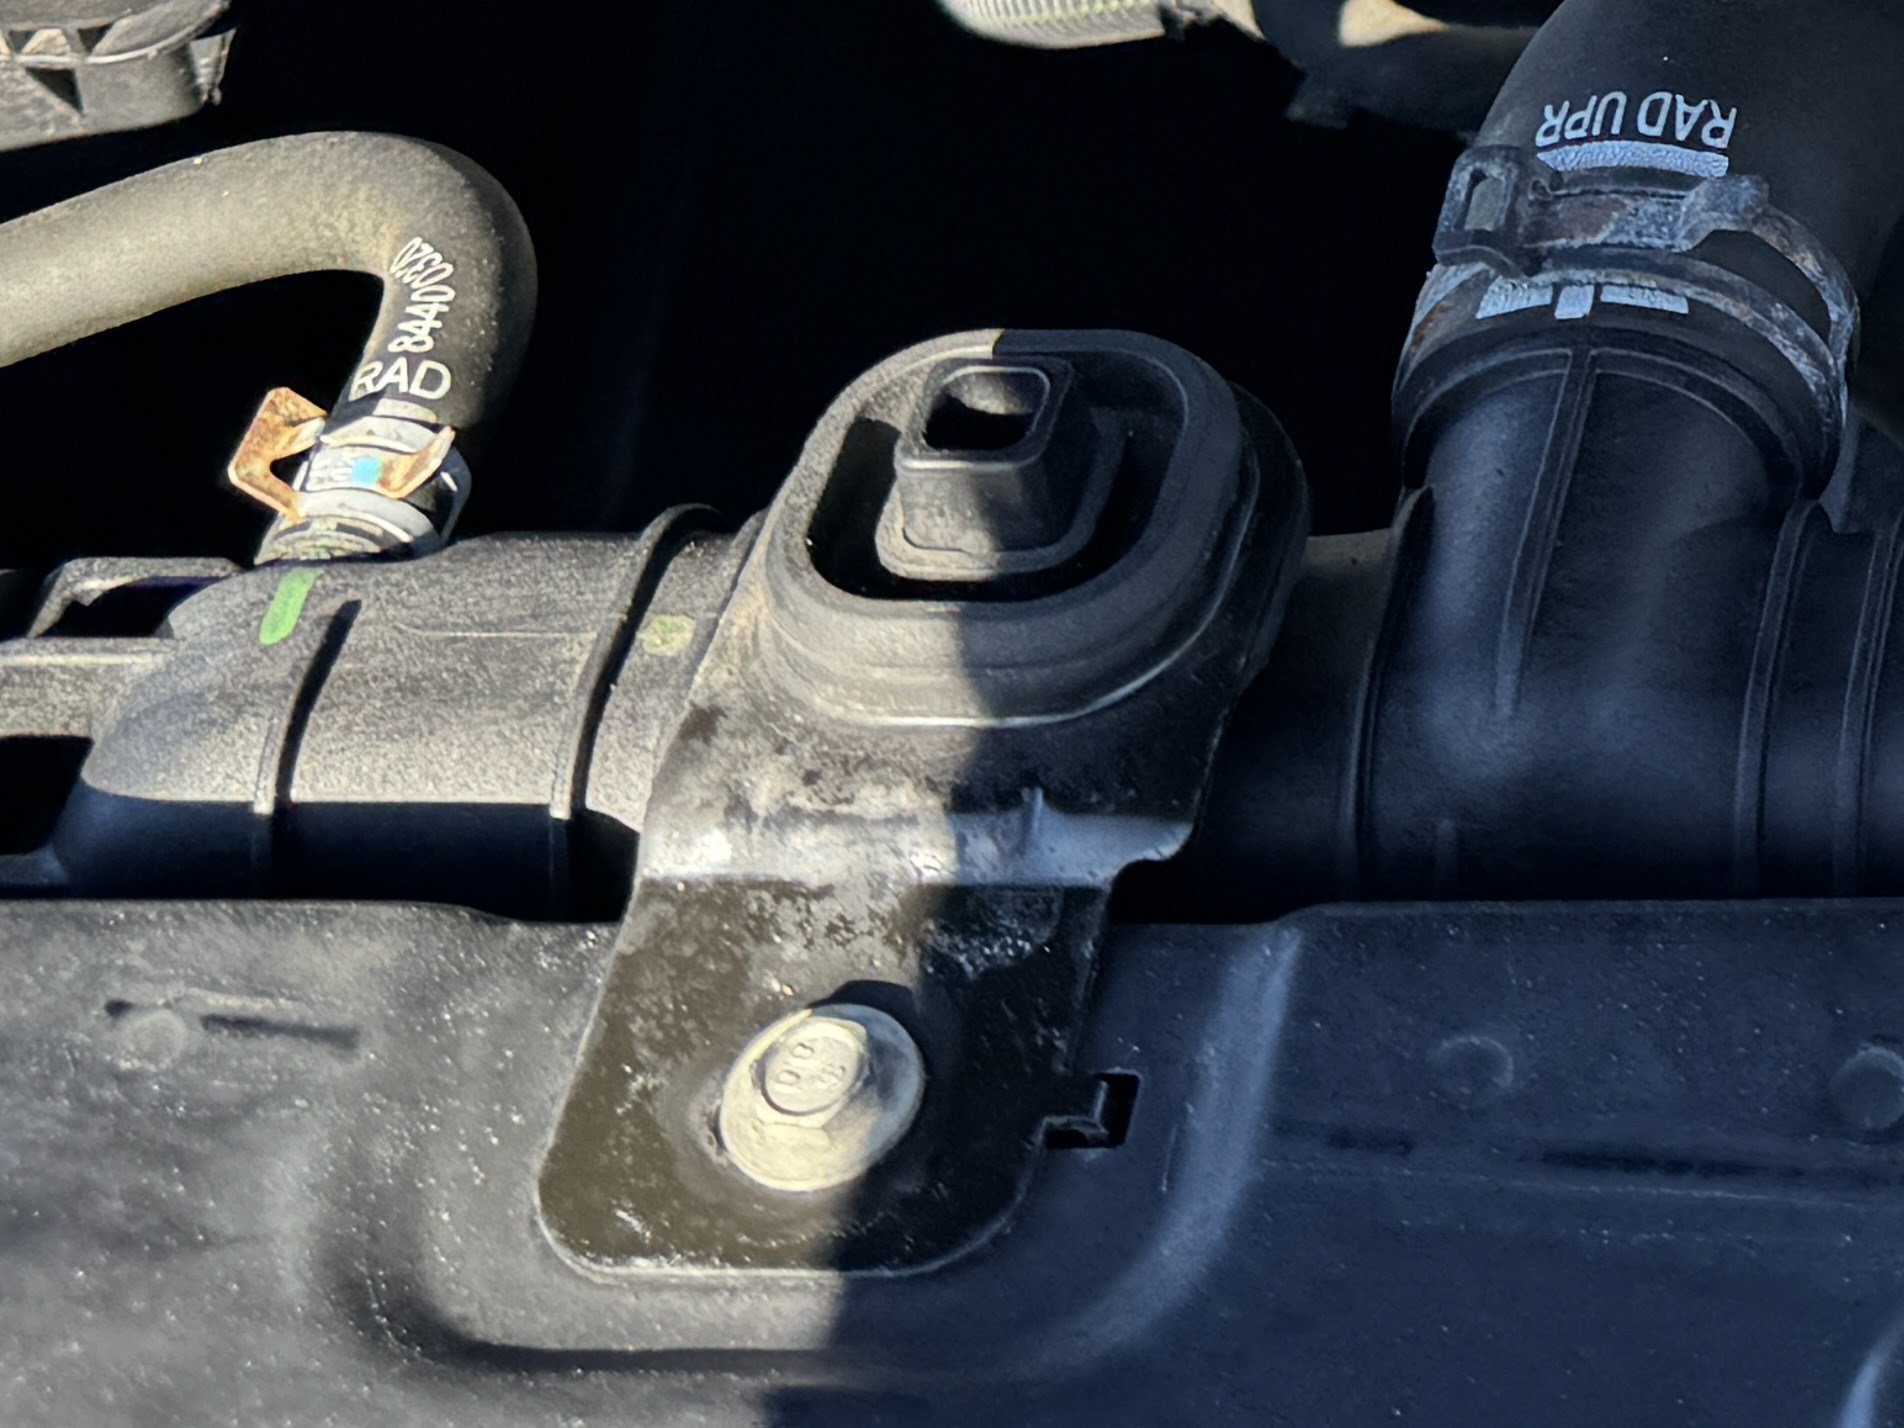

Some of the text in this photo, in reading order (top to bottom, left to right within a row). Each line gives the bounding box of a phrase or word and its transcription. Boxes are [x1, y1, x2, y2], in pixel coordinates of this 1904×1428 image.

[1535, 90, 1738, 149] RAD UPR
[349, 356, 452, 402] RAD
